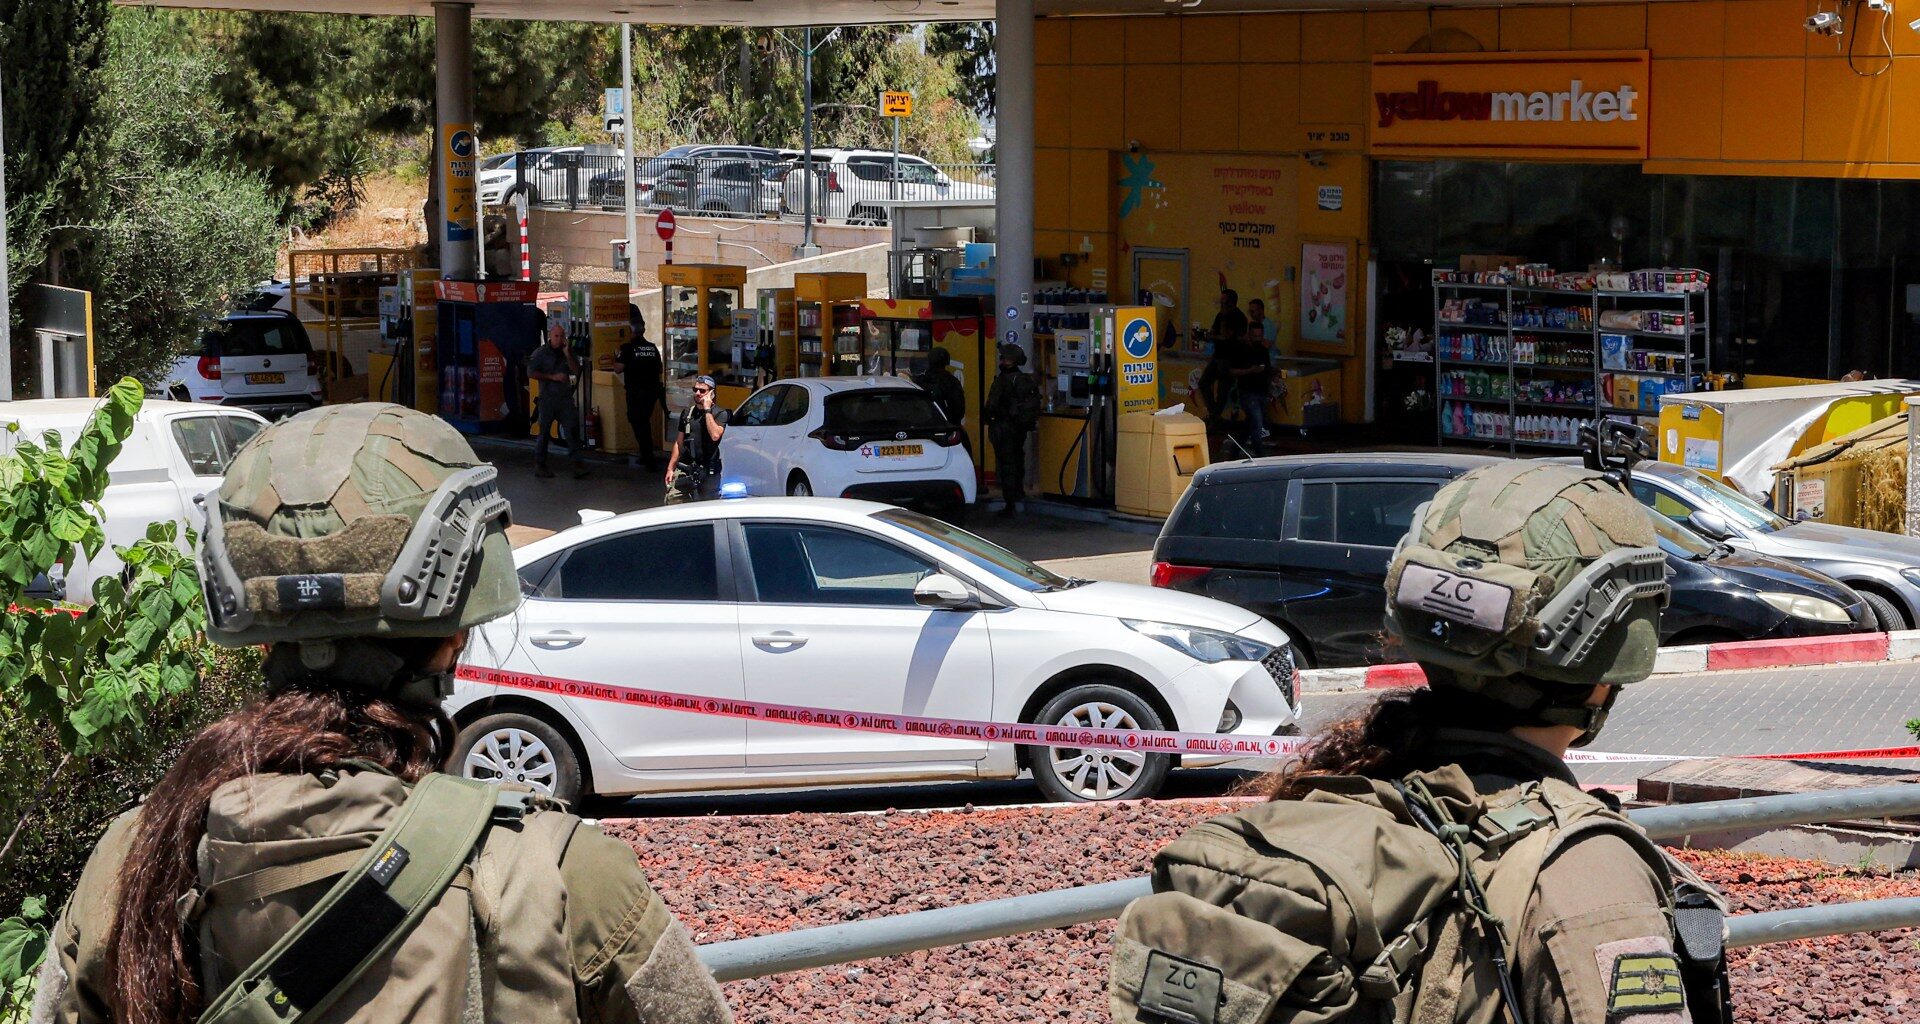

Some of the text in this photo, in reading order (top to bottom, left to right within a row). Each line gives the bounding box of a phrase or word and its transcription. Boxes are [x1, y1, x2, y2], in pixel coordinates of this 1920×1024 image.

[886, 94, 908, 105] יציאה
[1307, 132, 1350, 142] כוכב יאיר
[1228, 201, 1266, 216] yellow
[1219, 221, 1276, 236] ומקבלים כסף
[1233, 236, 1260, 248] בחזרה
[1124, 362, 1154, 373] שירות
[1126, 374, 1153, 384] עצמי
[1124, 396, 1155, 406] לשירותכם
[1430, 573, 1474, 602] Z.C
[1430, 620, 1443, 636] 2
[582, 686, 594, 696] אין
[594, 687, 618, 699] מעבר
[626, 692, 658, 705] משטרת
[722, 702, 733, 714] אין
[734, 705, 758, 716] מעבר
[765, 708, 796, 720] משטרת
[814, 713, 842, 726] ישראל
[860, 716, 872, 727] אין
[874, 718, 898, 730] מעבר
[905, 721, 936, 734] משטרת
[954, 726, 981, 738] ישראל
[1002, 726, 1013, 738] אין
[1014, 730, 1038, 740] מעבר
[1046, 731, 1078, 742] משטרת
[1094, 735, 1122, 748] ישראל
[1142, 735, 1153, 746] אין
[1154, 738, 1178, 748] מעבר
[1186, 739, 1218, 750] משטרת
[1234, 742, 1262, 754] ישראל
[374, 846, 396, 871] CORDURA
